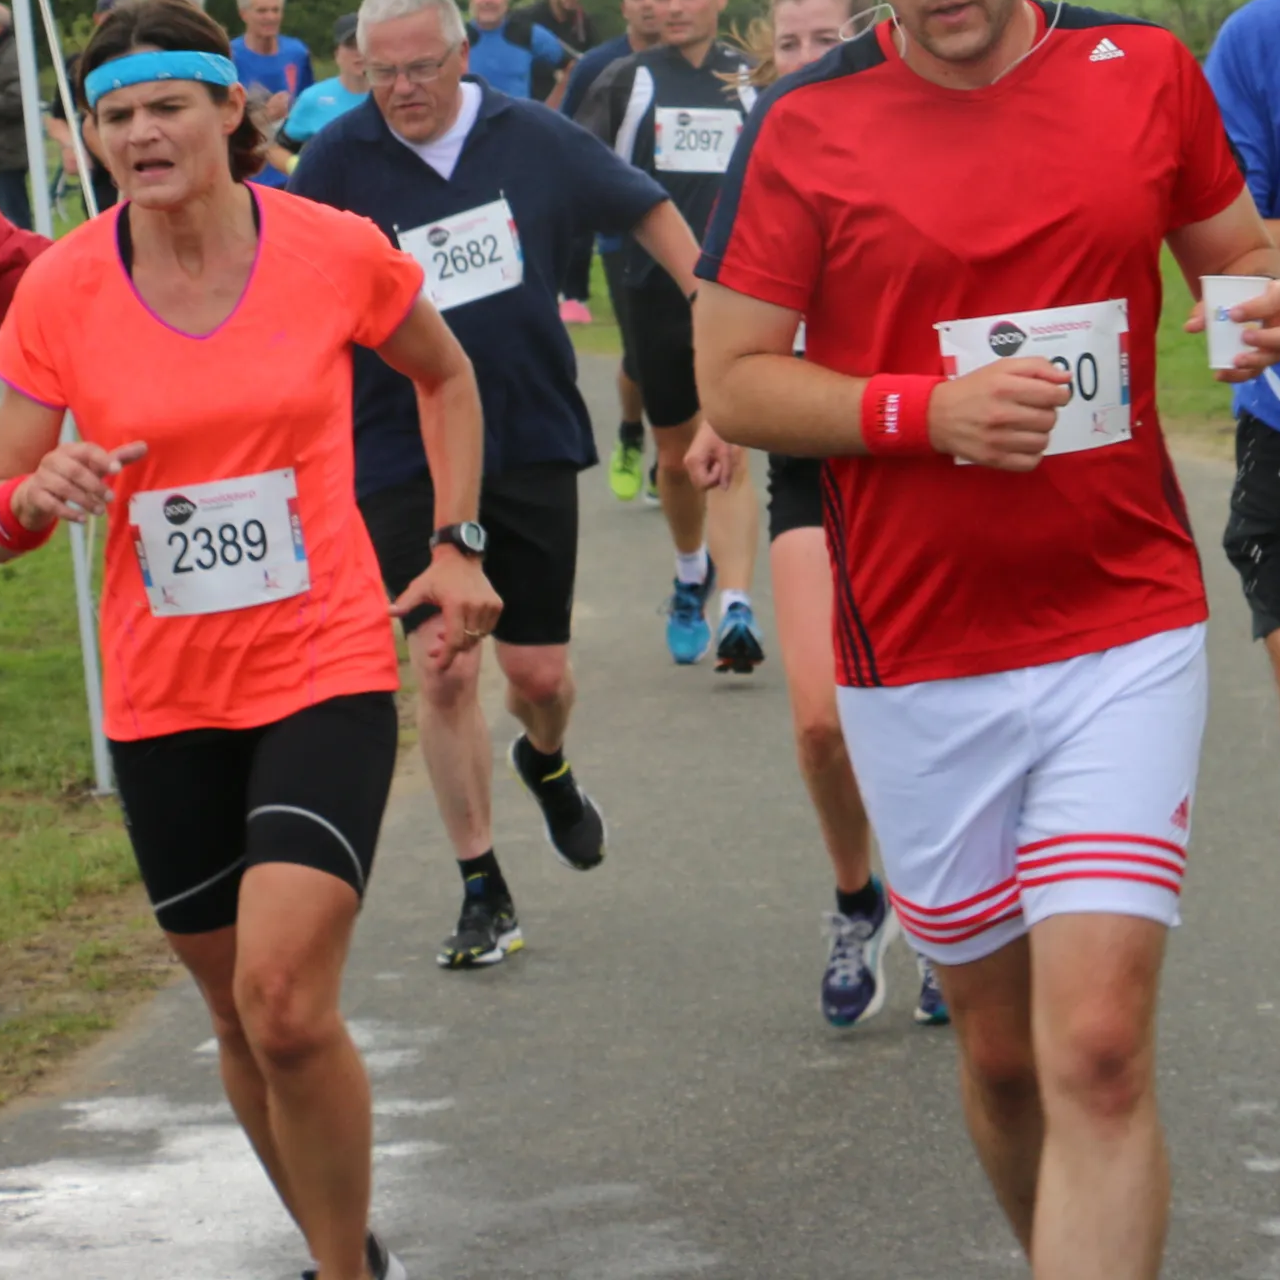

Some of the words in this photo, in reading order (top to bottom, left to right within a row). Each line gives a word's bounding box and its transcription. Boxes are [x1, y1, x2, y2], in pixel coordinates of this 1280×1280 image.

[674, 130, 724, 151] 2097
[433, 233, 503, 281] 2682
[167, 519, 268, 575] 2389
